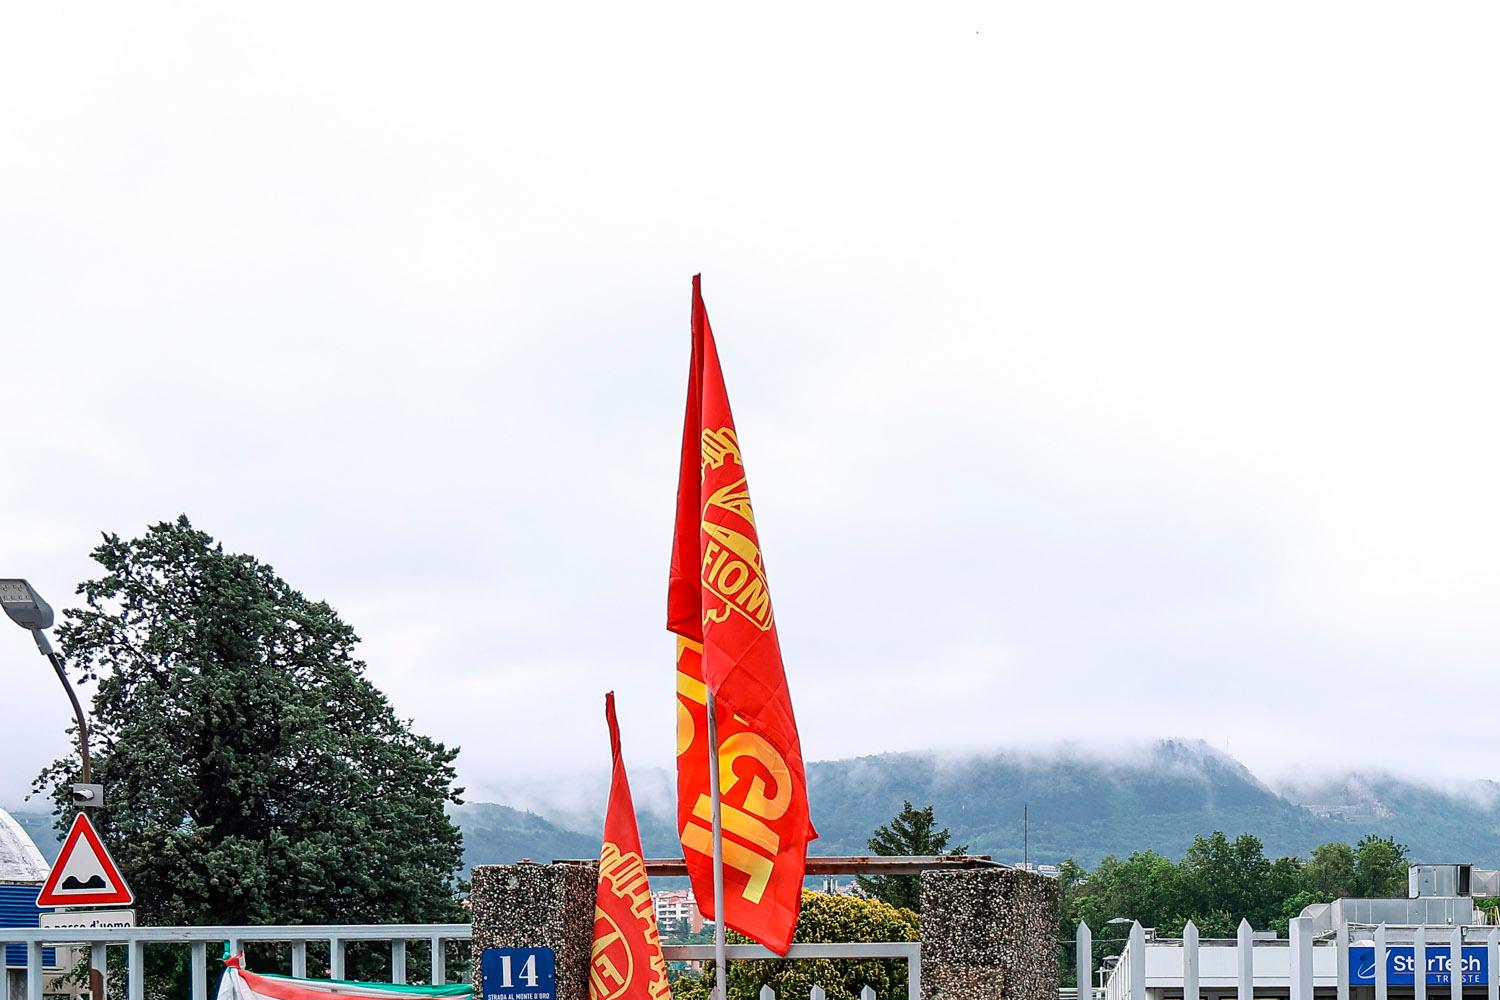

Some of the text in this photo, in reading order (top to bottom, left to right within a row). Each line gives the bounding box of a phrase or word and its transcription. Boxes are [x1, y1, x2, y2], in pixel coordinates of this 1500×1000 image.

[701, 540, 769, 621] FIOM
[1393, 955, 1481, 971] StrTech
[500, 955, 539, 988] 14
[1436, 974, 1480, 983] TRSTE
[487, 993, 507, 1000] STRADA
[533, 992, 550, 1000] D'ORO
